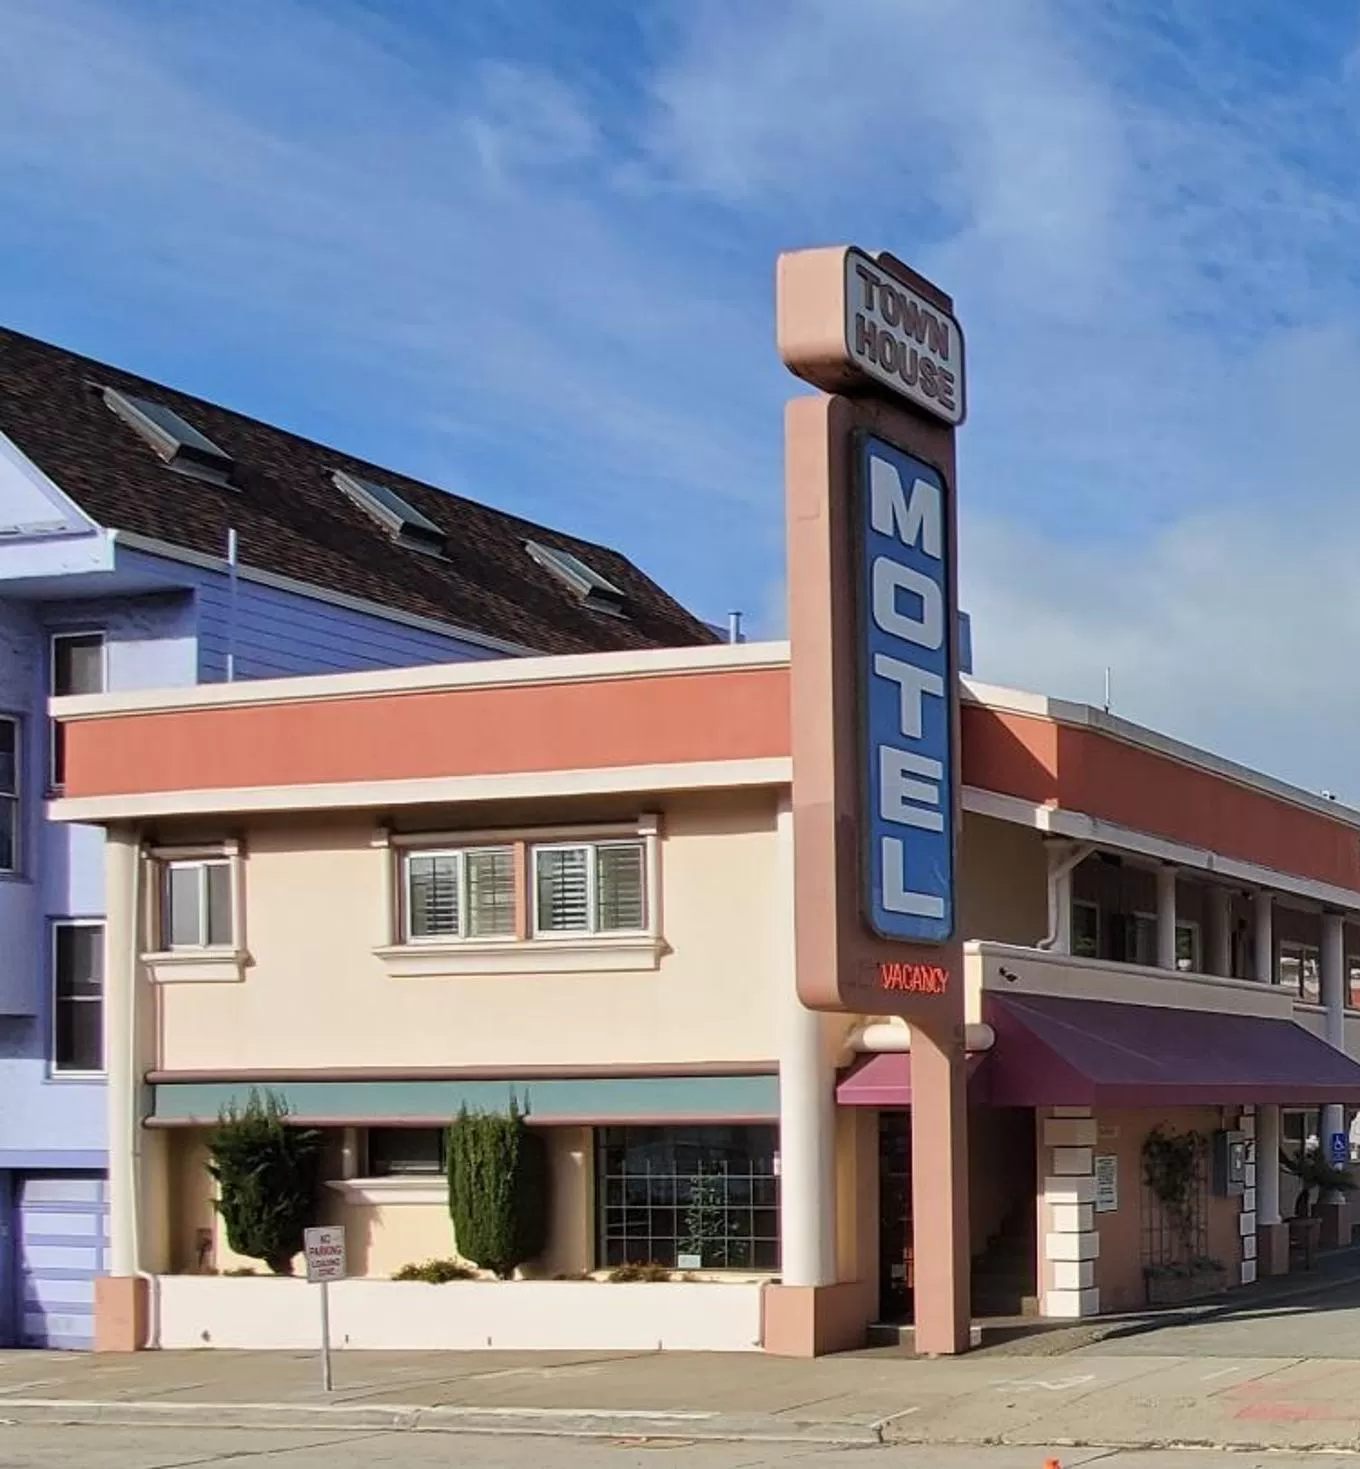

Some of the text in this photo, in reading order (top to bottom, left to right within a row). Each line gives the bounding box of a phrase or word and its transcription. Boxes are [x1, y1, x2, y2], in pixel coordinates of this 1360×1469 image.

[856, 264, 949, 360] TOWN
[856, 313, 955, 411] HOUSE
[868, 454, 945, 919] MOTEL
[881, 963, 949, 993] VACANCY
